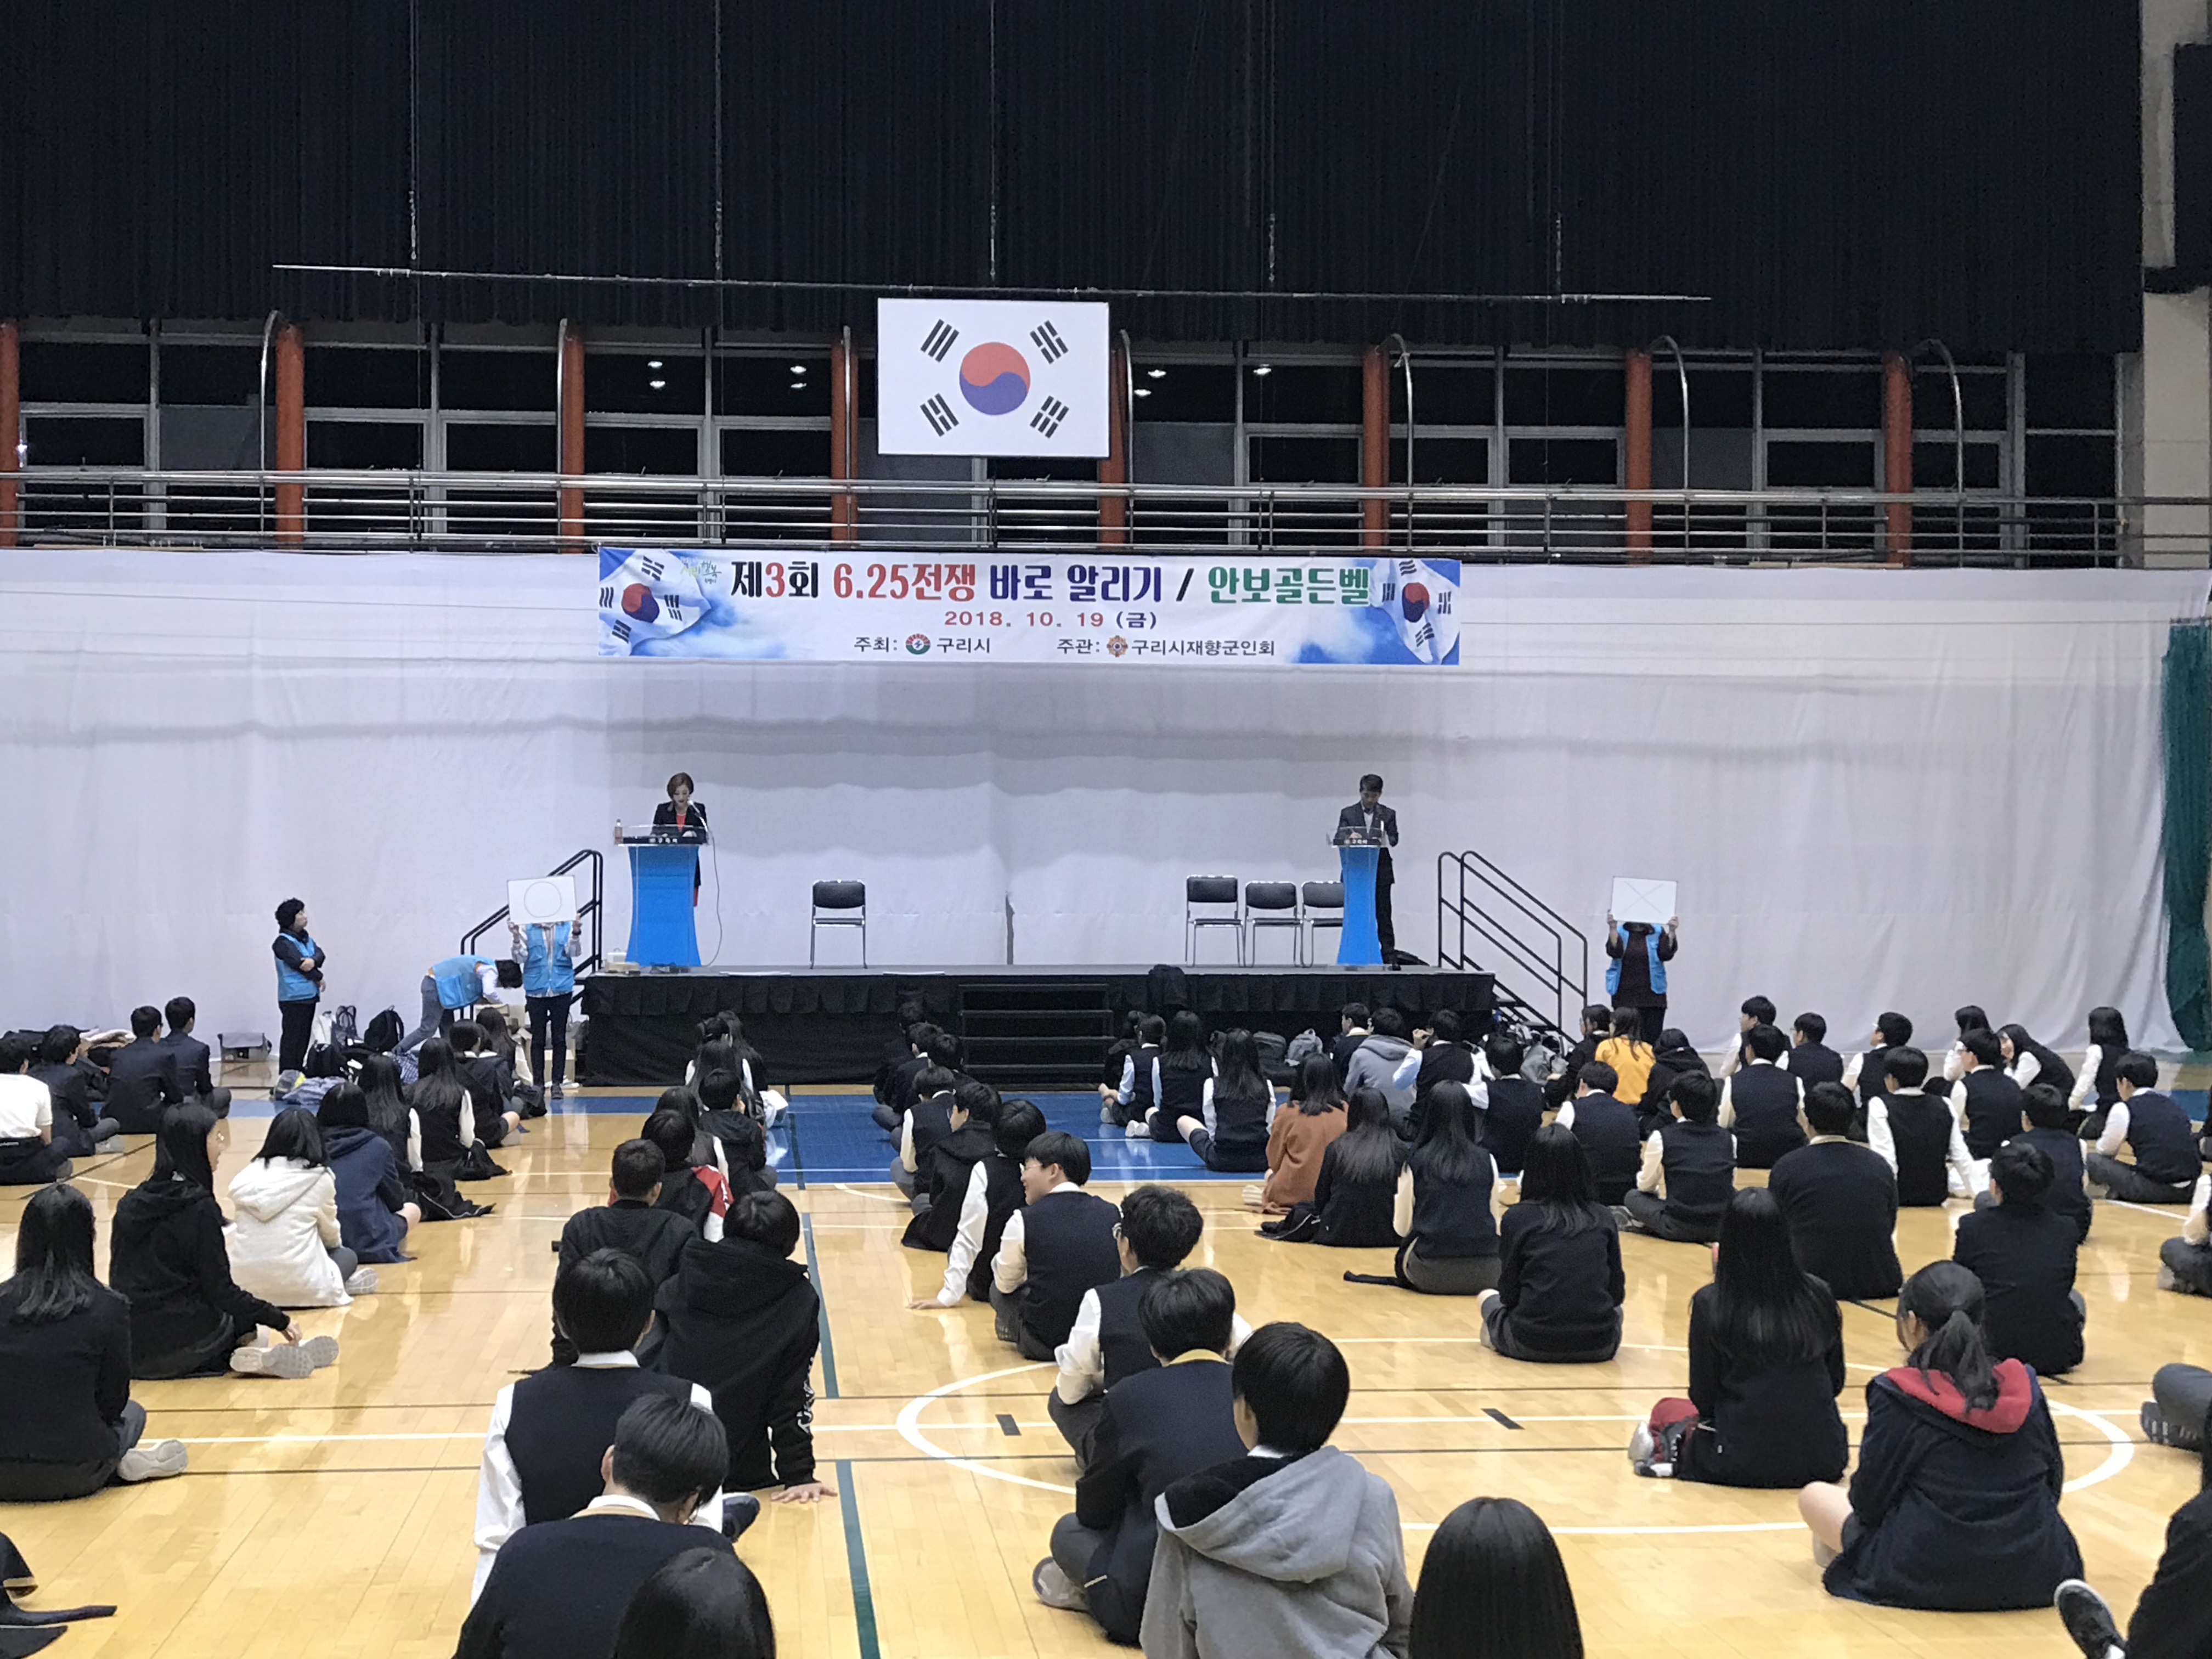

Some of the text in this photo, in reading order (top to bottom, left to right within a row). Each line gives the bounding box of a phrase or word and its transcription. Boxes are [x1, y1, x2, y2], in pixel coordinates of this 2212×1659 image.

[731, 561, 1370, 606] 제3회 6.25전쟁 바로 알리기 / 안보골든벨
[944, 611, 1156, 629] 2018. 10. 19 (금)
[855, 637, 990, 653] 주최: 구리시
[1057, 639, 1274, 657] 주관: 구리시재향군인회
